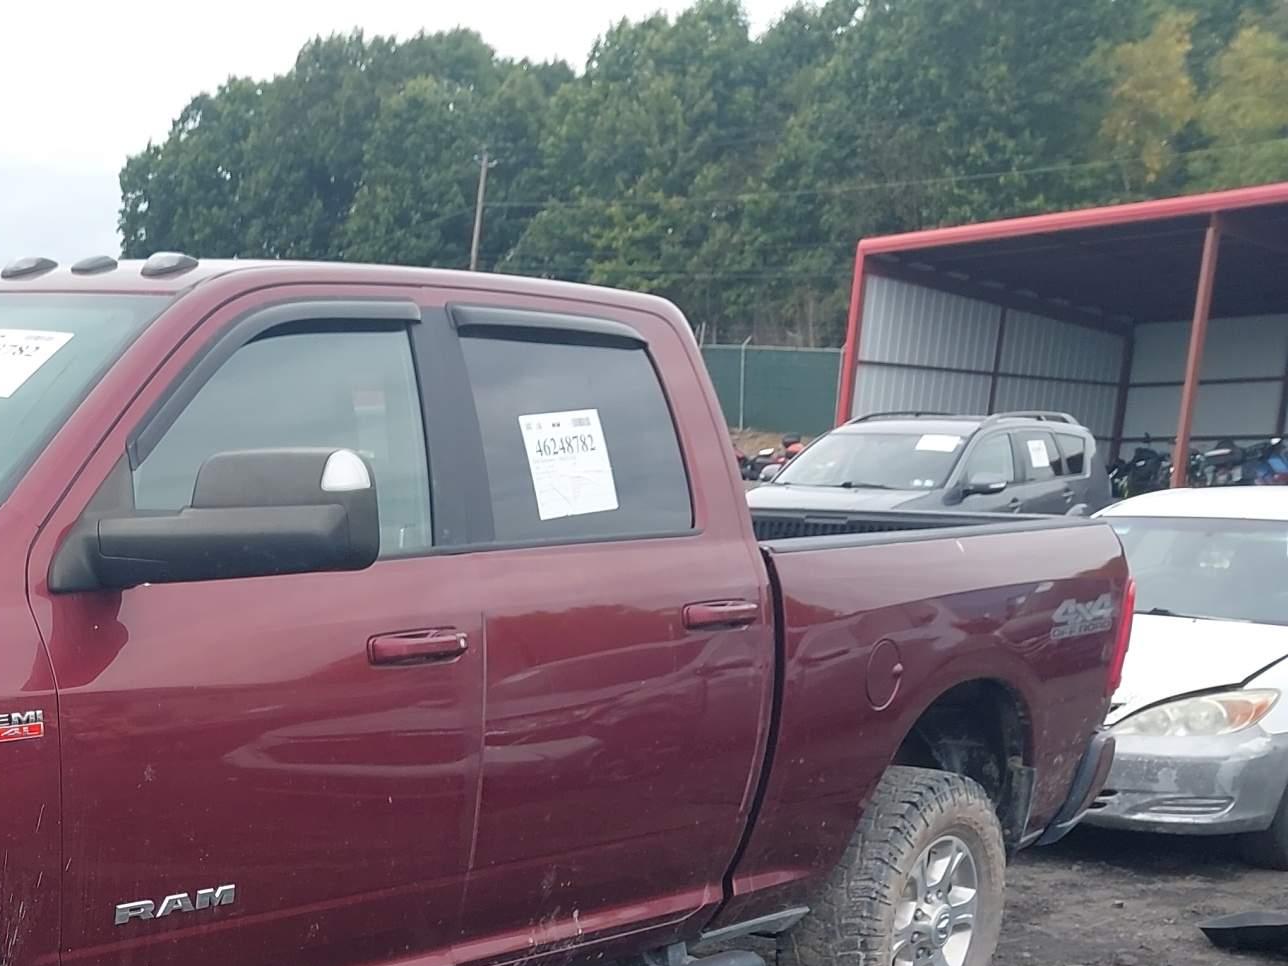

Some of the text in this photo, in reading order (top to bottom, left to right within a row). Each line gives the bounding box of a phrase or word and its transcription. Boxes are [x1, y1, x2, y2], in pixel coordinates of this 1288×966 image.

[536, 434, 596, 456] 46248782
[1053, 626, 1078, 637] OFF
[114, 884, 236, 925] RAM
